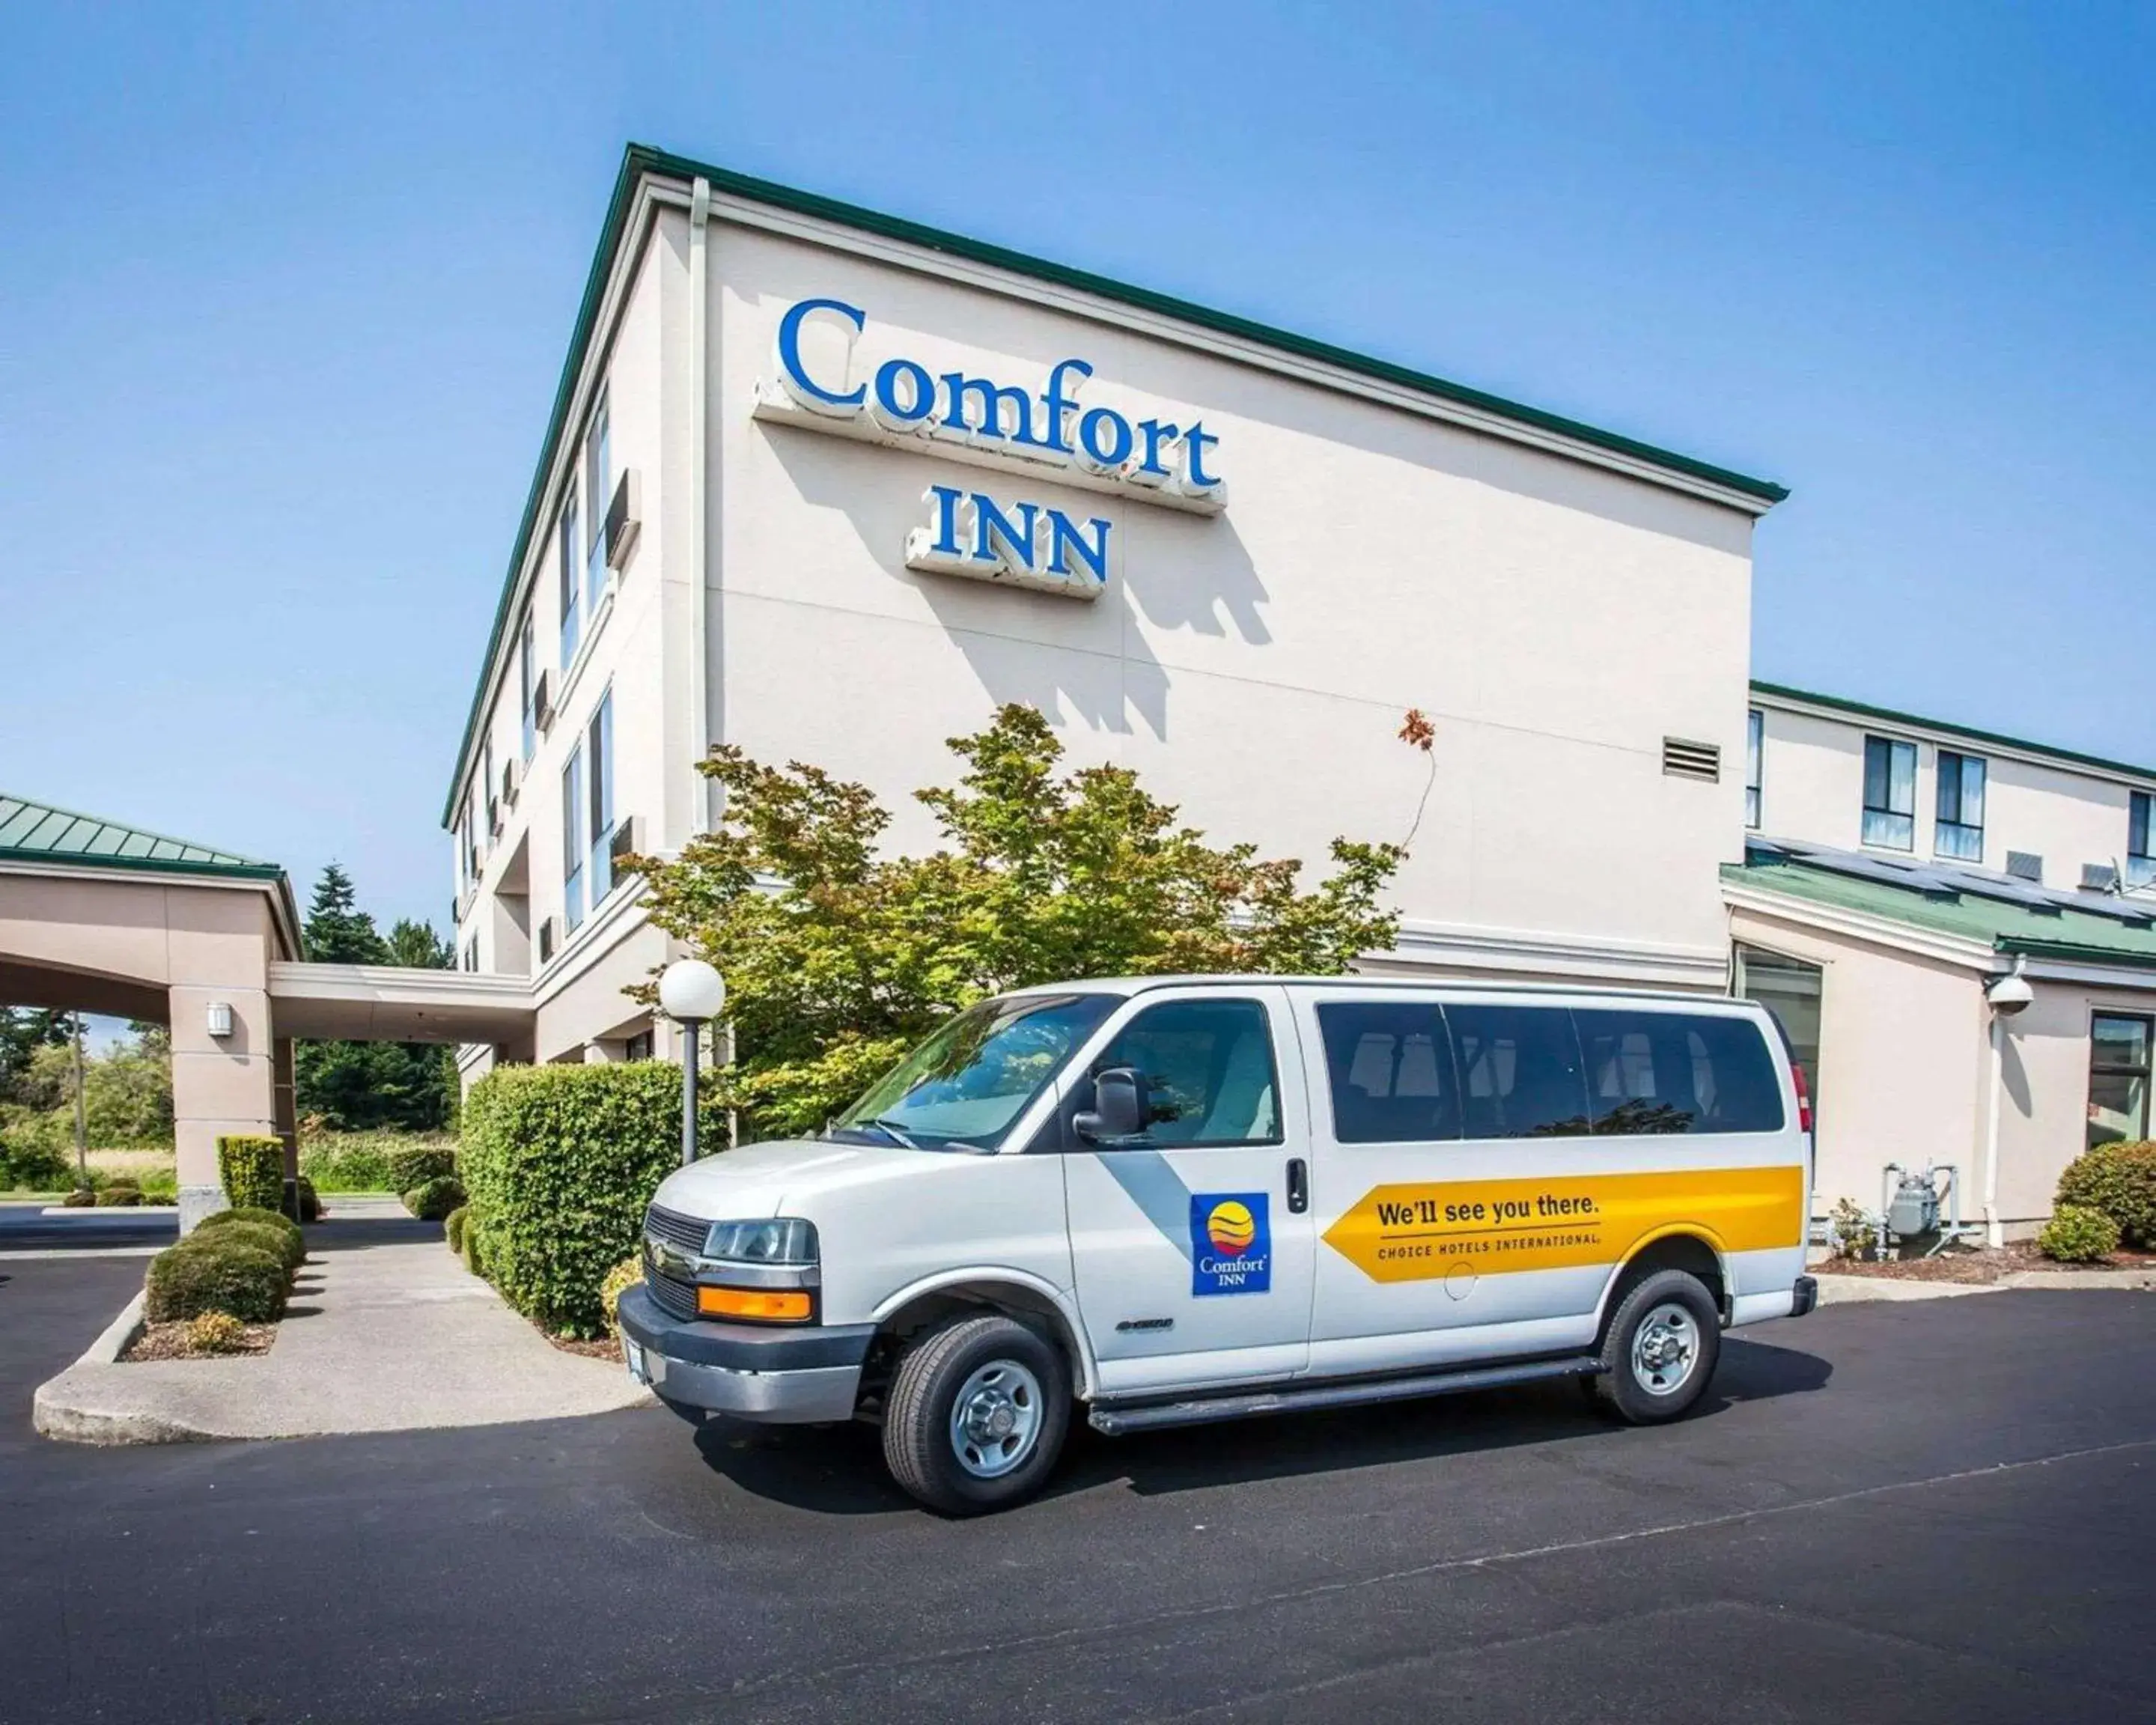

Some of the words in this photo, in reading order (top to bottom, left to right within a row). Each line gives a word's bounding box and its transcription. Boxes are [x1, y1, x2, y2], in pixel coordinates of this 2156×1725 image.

[778, 299, 1222, 487] Comfort
[930, 484, 1112, 582] INN
[1377, 1200, 1437, 1226] We'll
[1445, 1203, 1484, 1222] see
[1492, 1200, 1530, 1224] you
[1537, 1195, 1599, 1217] there.
[1377, 1245, 1432, 1259] CHOICE
[1439, 1241, 1490, 1255] HOTELS
[1199, 1254, 1264, 1274] Comfort
[1218, 1273, 1246, 1286] INN
